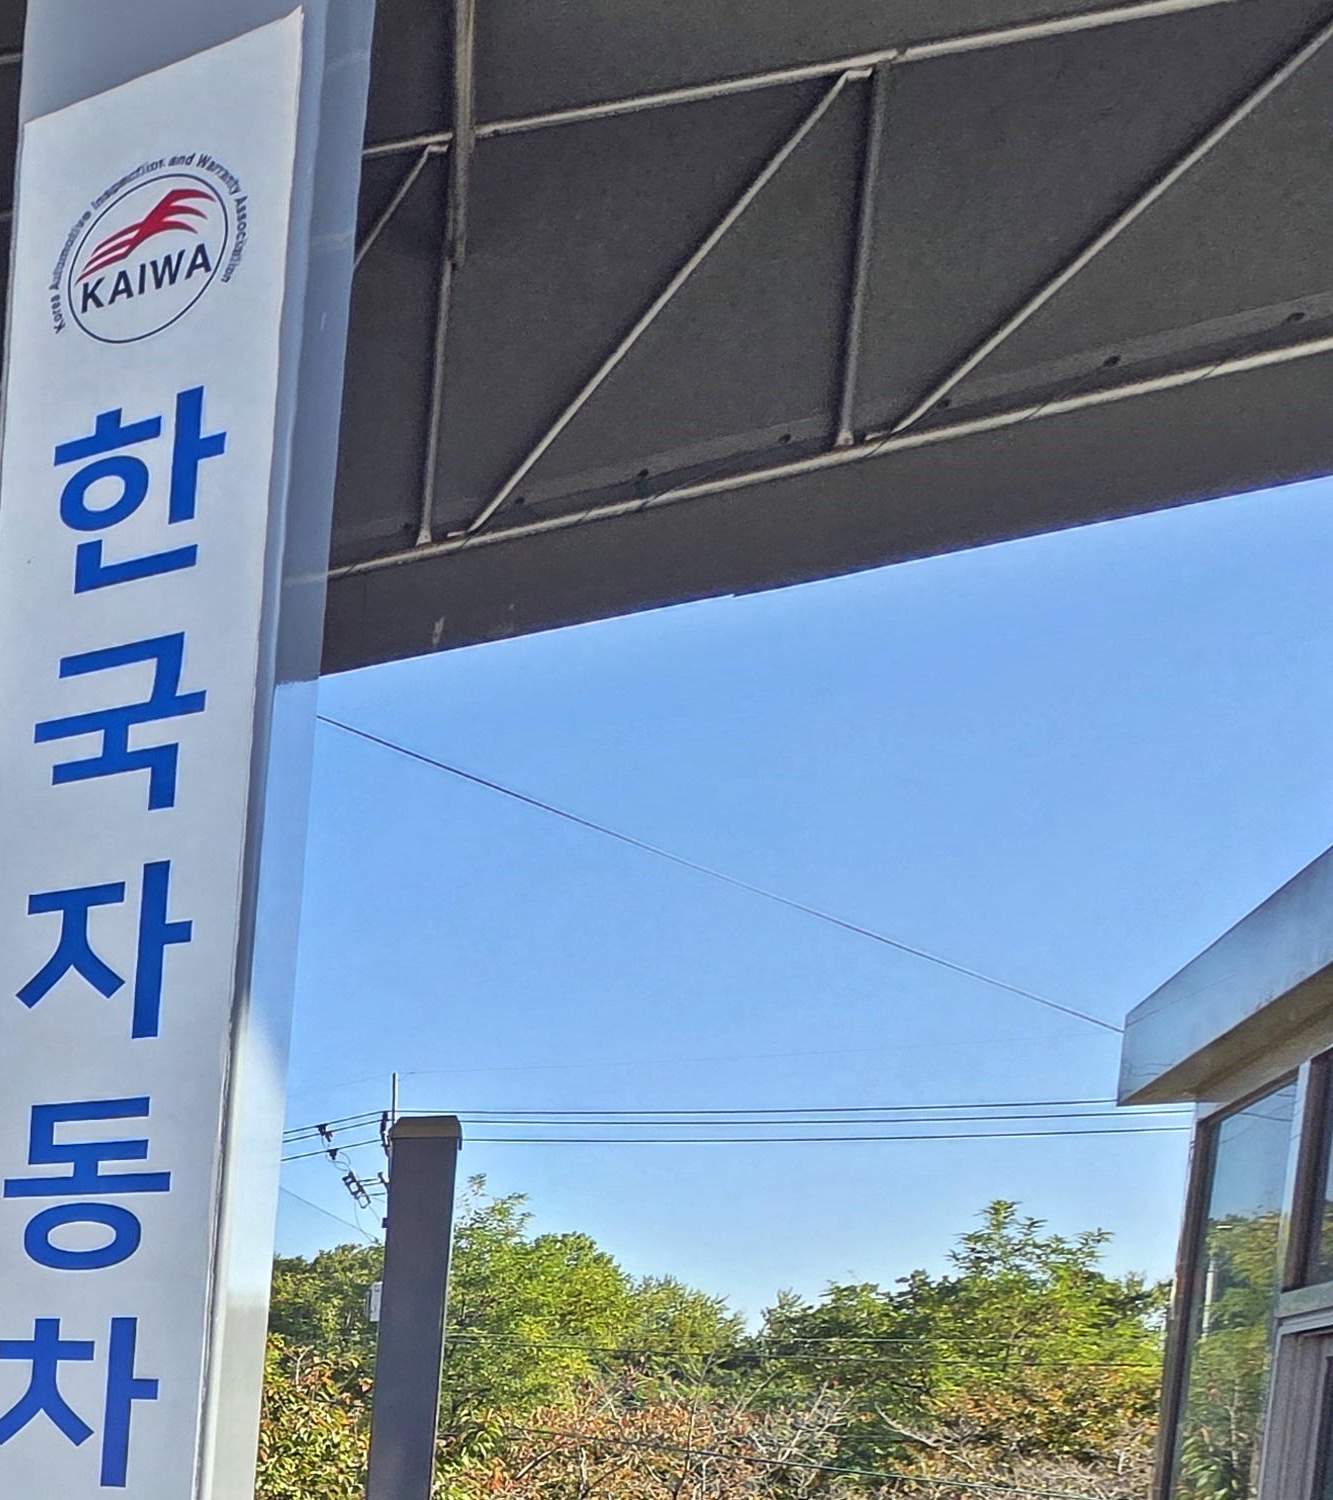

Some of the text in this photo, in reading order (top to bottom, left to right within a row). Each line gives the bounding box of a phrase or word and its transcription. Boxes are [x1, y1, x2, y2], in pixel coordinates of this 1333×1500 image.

[49, 294, 66, 335] Korea
[168, 152, 197, 168] and
[196, 153, 241, 196] Warranty
[221, 195, 248, 284] Association
[80, 242, 213, 315] KAIWA
